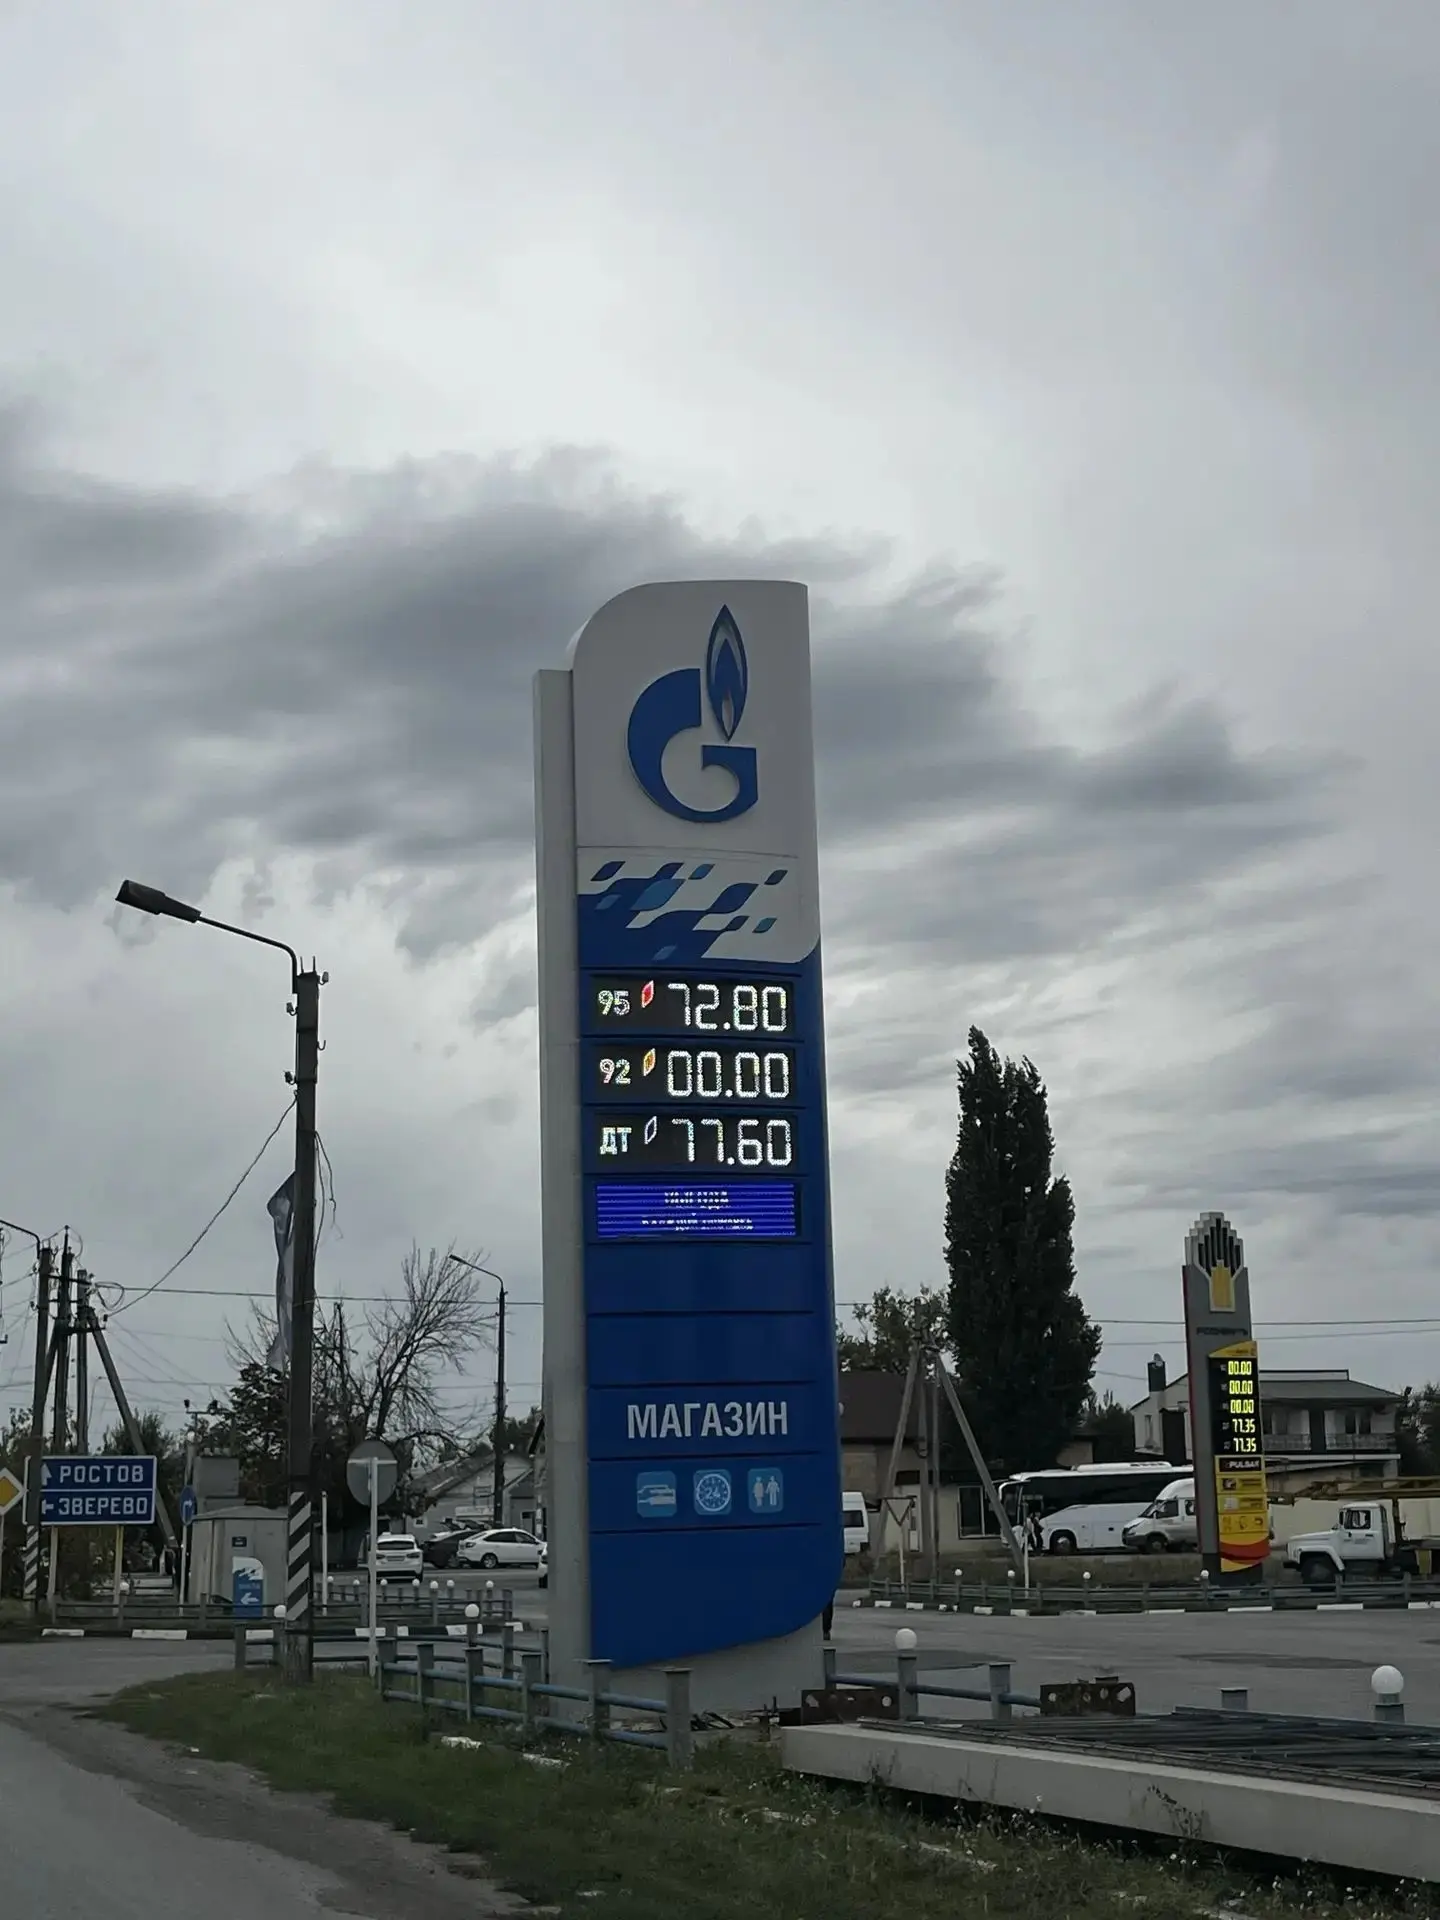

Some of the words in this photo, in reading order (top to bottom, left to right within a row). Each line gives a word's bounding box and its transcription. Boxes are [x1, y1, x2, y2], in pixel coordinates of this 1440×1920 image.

[598, 990, 630, 1016] 95
[668, 982, 787, 1031] 72.80
[600, 1059, 632, 1084] 92
[667, 1050, 789, 1098] 00.00
[599, 1127, 632, 1155] ДТ
[671, 1118, 792, 1166] 77.60
[1228, 1361, 1252, 1375] 00.00
[1229, 1380, 1253, 1395] 00.00
[1230, 1399, 1254, 1414] 00.00
[627, 1401, 788, 1439] МАГАЗИН
[59, 1465, 144, 1484] РОСТОВ
[58, 1497, 148, 1516] ЗВЕРЕВО
